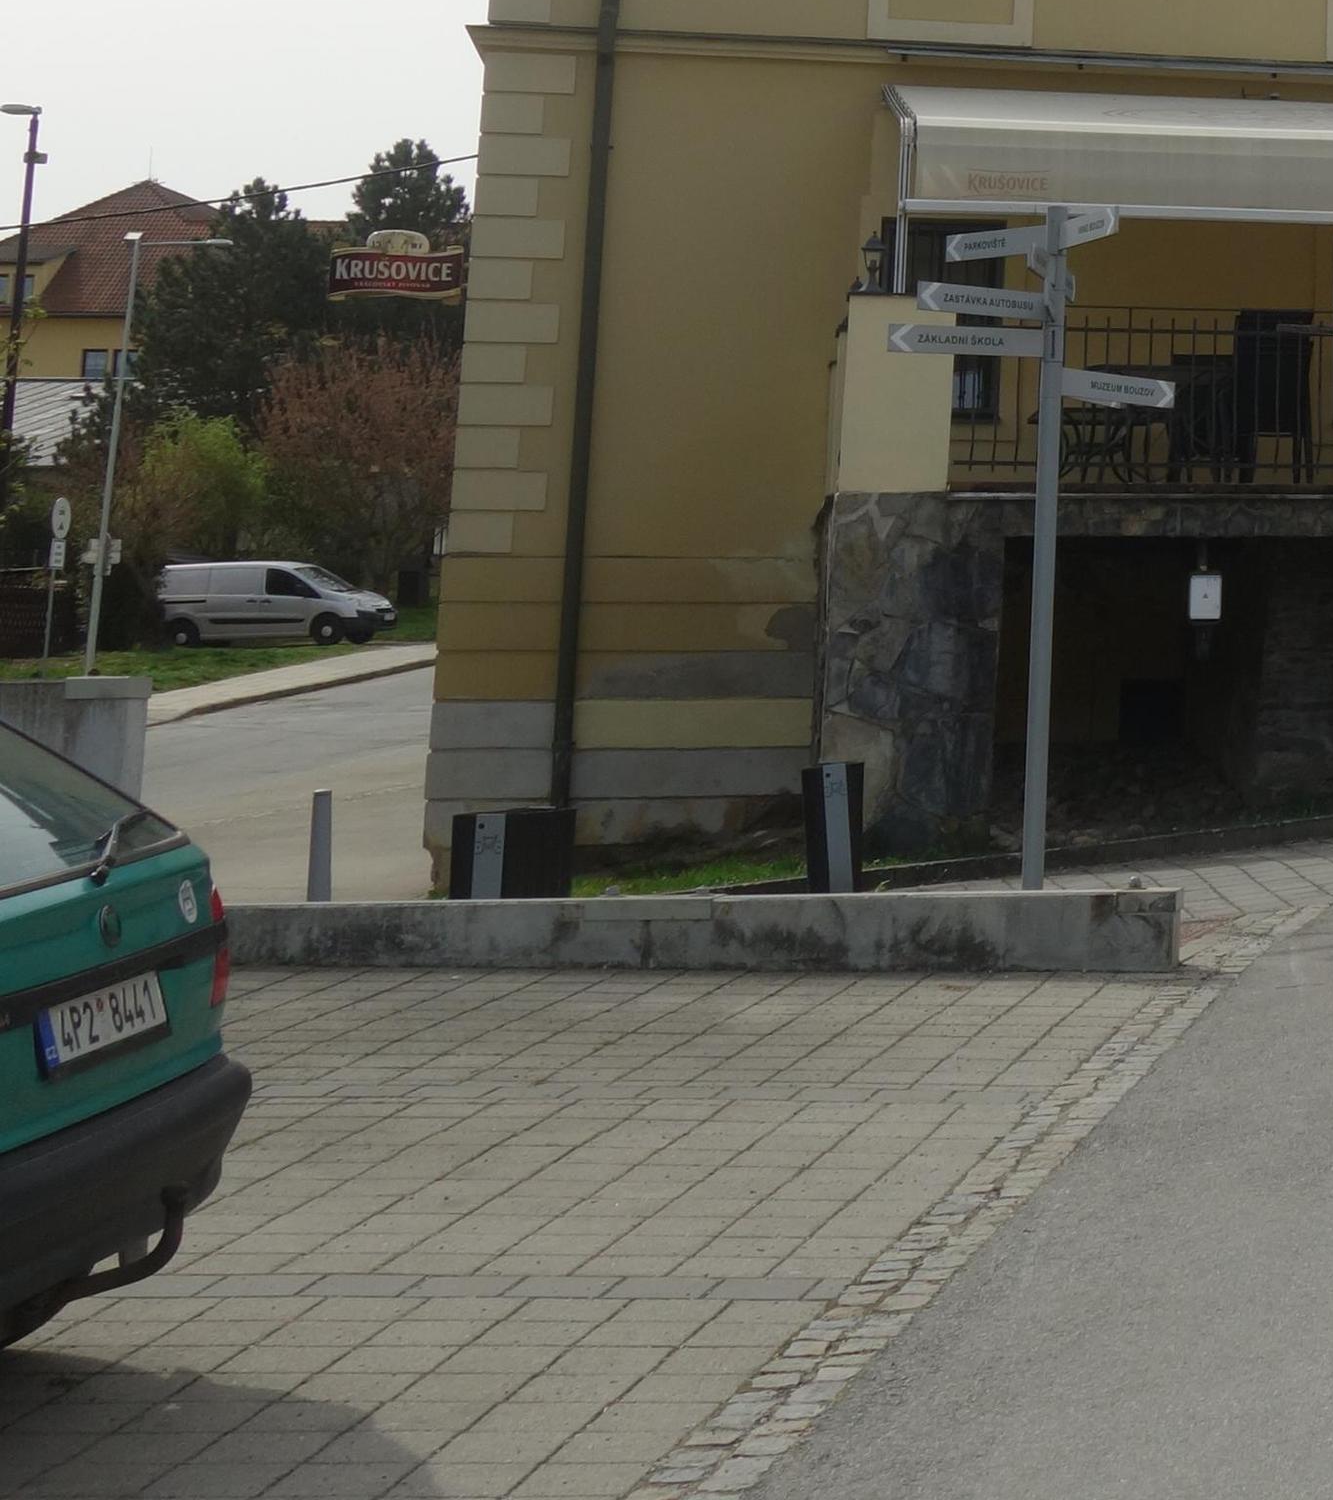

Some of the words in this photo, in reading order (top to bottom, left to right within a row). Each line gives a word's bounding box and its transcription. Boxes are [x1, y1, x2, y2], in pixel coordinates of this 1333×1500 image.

[335, 256, 453, 282] KRUŠOVICE
[943, 292, 988, 306] ZASTÁVKA
[989, 298, 1034, 311] AUTOBUSU
[970, 334, 1005, 347] ŠKOLA
[60, 1000, 99, 1052] 4P2
[110, 980, 157, 1034] 8441
